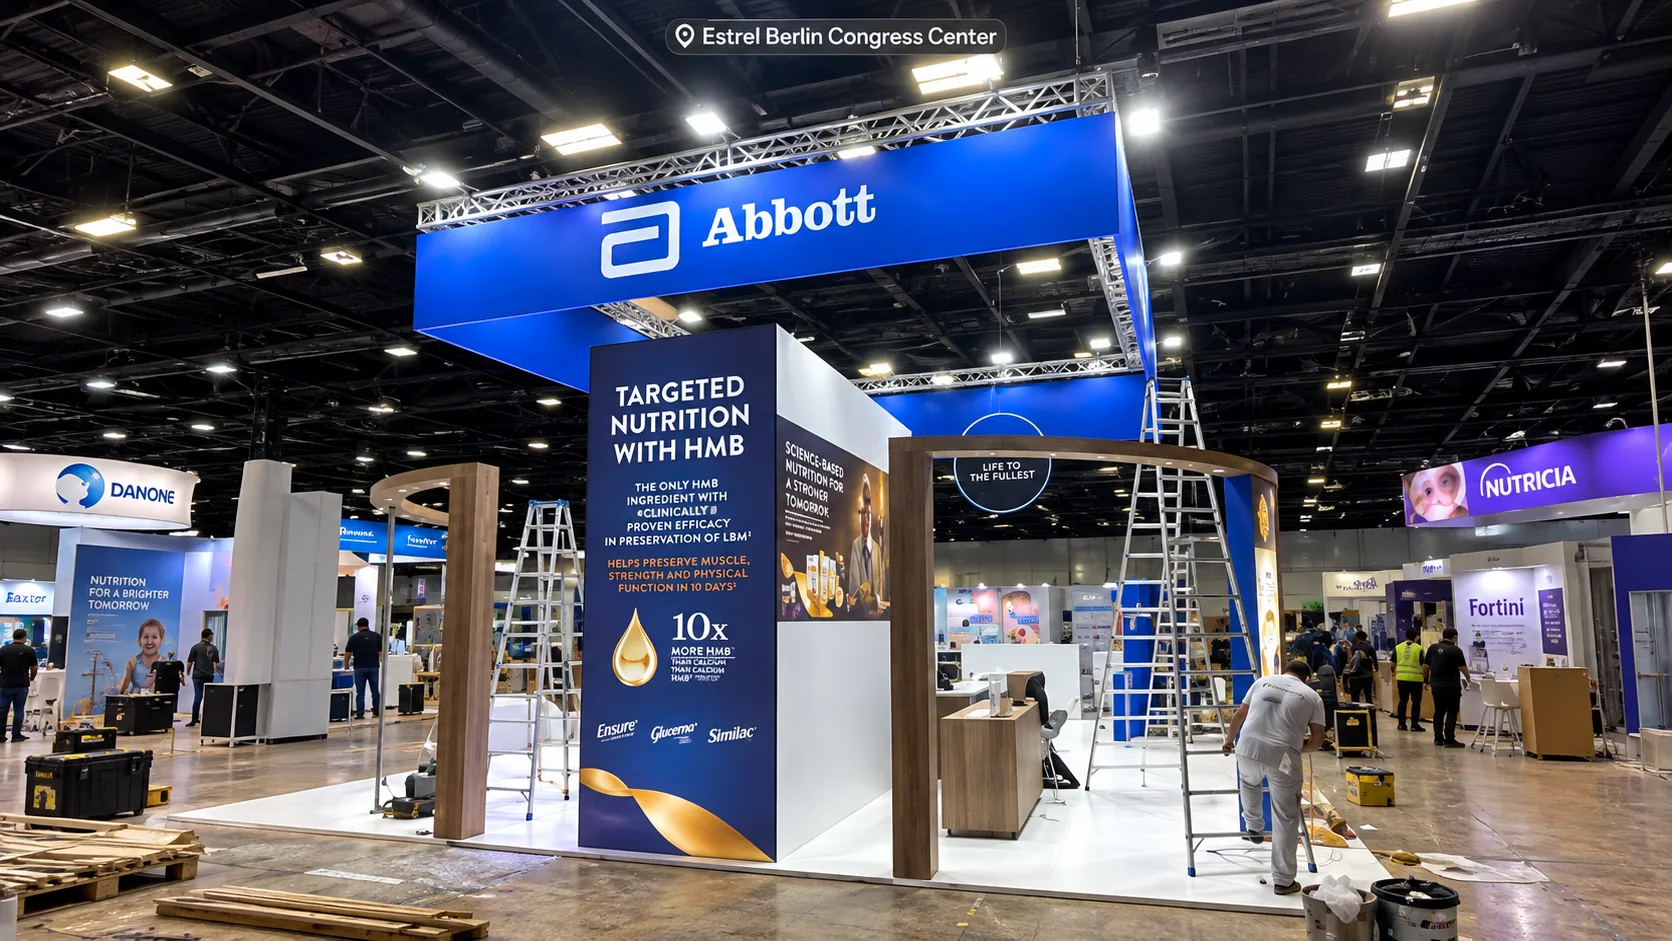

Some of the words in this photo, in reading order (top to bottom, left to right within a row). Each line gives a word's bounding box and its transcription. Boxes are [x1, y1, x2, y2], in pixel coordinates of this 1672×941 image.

[702, 184, 876, 248] Abbott
[615, 375, 745, 407] TARGETED
[611, 403, 750, 436] NUTRITION
[613, 439, 676, 465] WITH
[684, 434, 745, 460] HMB
[785, 441, 844, 478] SCIENCE-BASED
[982, 462, 1004, 471] LIFE
[1006, 461, 1021, 470] TO
[970, 472, 990, 481] THE
[992, 470, 1035, 480] FULLEST
[1485, 465, 1577, 498] NUTRICIA
[635, 483, 656, 492] THE
[659, 480, 690, 491] ONLY
[692, 478, 719, 489] HMB
[110, 482, 175, 504] DANONE
[627, 493, 695, 505] INGREDIENT
[698, 491, 728, 501] WITH
[627, 521, 672, 532] PROVEN
[675, 518, 731, 530] EFFICACY
[605, 537, 616, 546] IN
[619, 533, 701, 545] PRESERVATION
[704, 532, 720, 543] OF
[607, 559, 640, 568] HELPS
[643, 557, 698, 567] PRESERVE
[701, 555, 751, 566] MUSCLE,
[90, 575, 147, 587] NUTRITION
[608, 571, 664, 580] STRENGTH
[666, 569, 691, 579] AND
[694, 568, 748, 579] PHYSICAL
[89, 588, 110, 598] FOR
[113, 589, 119, 598] A
[122, 589, 169, 599] BRIGHTER
[618, 583, 674, 592] FUNCTION
[676, 582, 688, 591] IN
[691, 582, 702, 591] 10
[88, 600, 150, 610] TOMORROW
[1469, 597, 1524, 616] Fortini
[672, 612, 729, 641] 10x
[671, 646, 703, 655] MORE
[597, 721, 636, 738] Ensure
[707, 726, 754, 743] Similac
